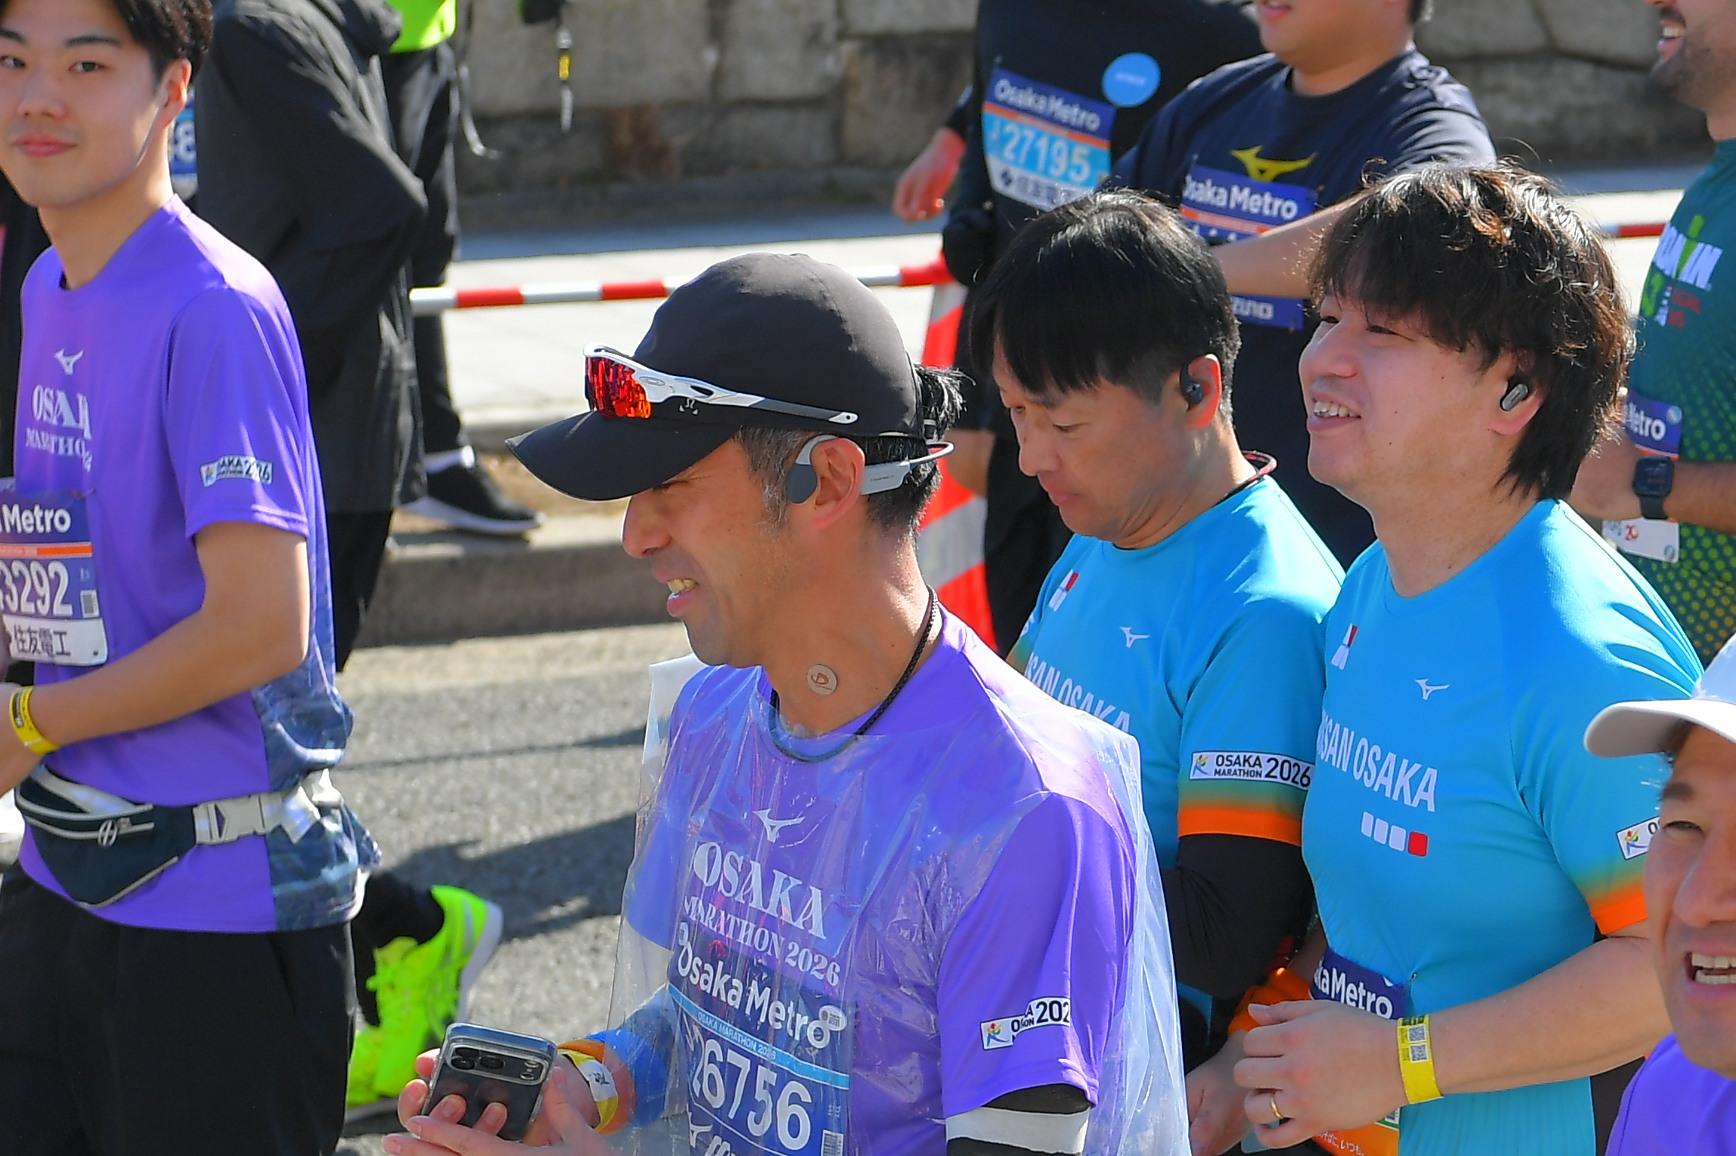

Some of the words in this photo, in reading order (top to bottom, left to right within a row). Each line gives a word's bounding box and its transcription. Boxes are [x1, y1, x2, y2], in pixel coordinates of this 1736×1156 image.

[1002, 122, 1092, 184] 27195
[1229, 184, 1299, 221] Metro
[2, 503, 72, 535] Metro
[0, 559, 74, 618] 3292
[1213, 768, 1262, 780] MARATHON
[1215, 754, 1262, 769] OSAKA
[1264, 757, 1312, 787] 2026
[1352, 736, 1439, 813] OSAKA
[693, 841, 827, 941] OSAKA
[785, 941, 842, 987] 2026
[677, 941, 743, 1010] Osaka
[744, 980, 831, 1049] Metro
[1331, 966, 1393, 1020] Metro
